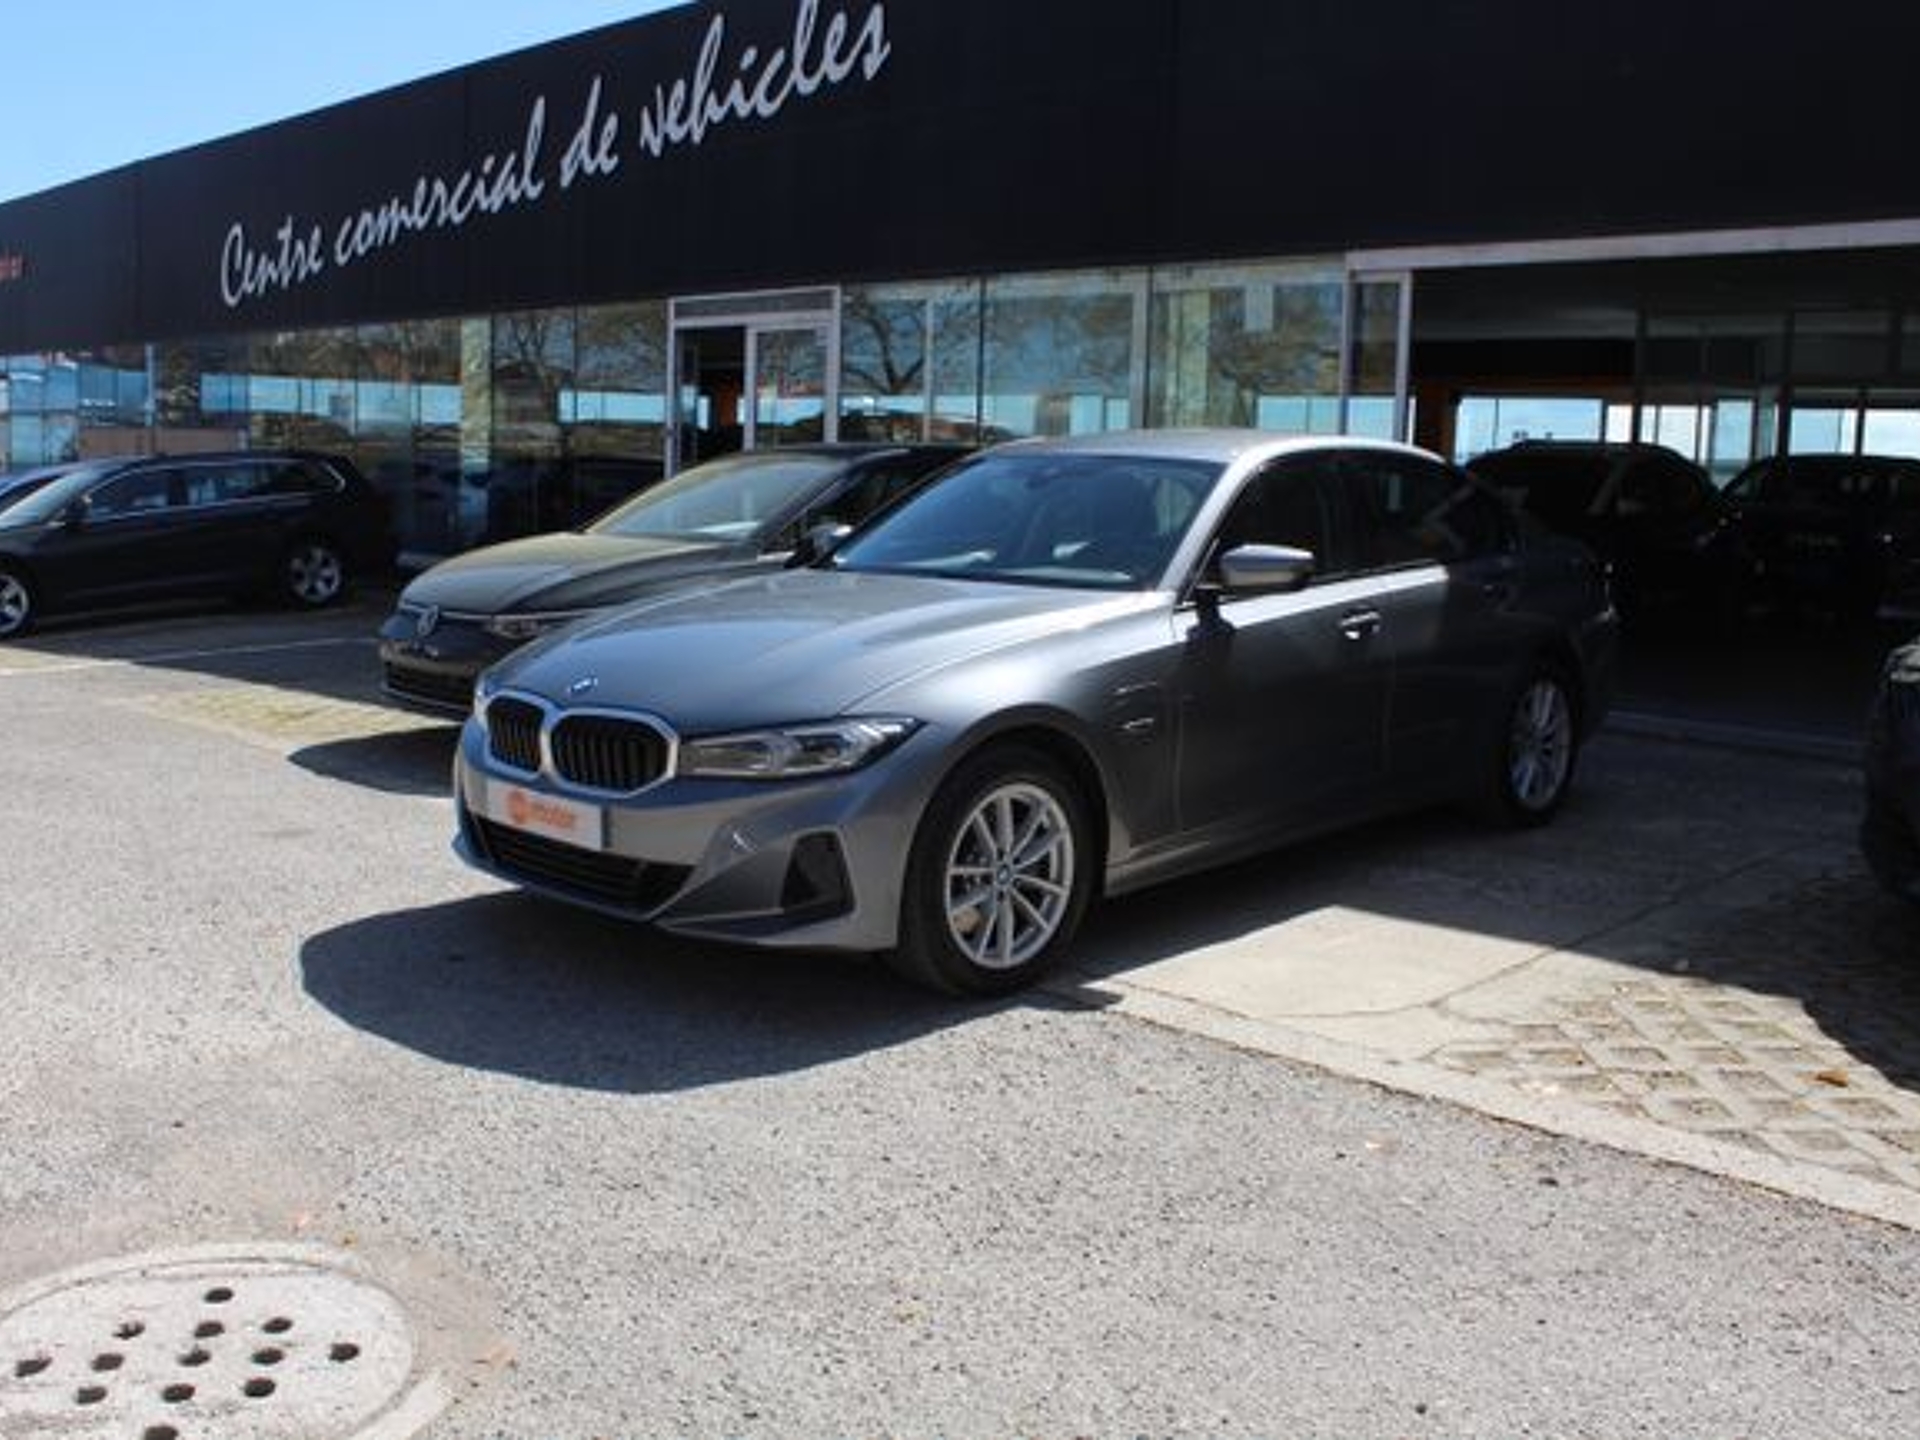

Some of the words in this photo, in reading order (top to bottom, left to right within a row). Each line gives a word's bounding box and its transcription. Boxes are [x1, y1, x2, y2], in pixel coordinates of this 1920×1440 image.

[221, 223, 323, 306] Centre
[335, 96, 544, 266] comercial
[561, 77, 618, 187] de
[640, 0, 891, 157] vehicles
